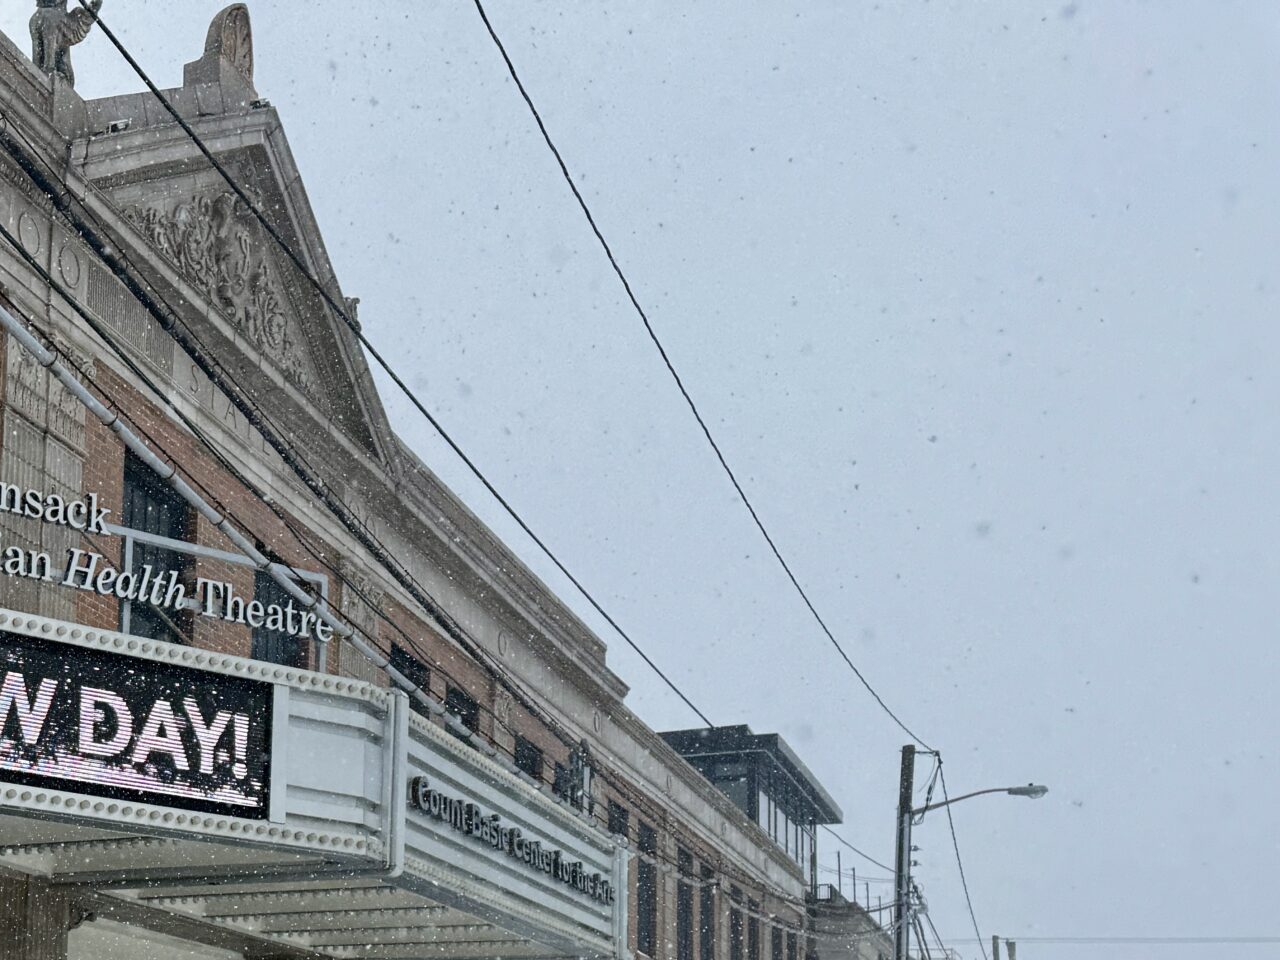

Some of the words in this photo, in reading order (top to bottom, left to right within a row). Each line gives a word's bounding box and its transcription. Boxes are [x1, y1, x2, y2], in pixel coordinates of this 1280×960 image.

[61, 548, 187, 611] Health
[196, 577, 334, 642] Theatre
[77, 685, 249, 780] DAY!
[411, 776, 469, 833] Count
[470, 803, 510, 852] Basie
[510, 827, 555, 874] Center
[554, 850, 577, 886] for
